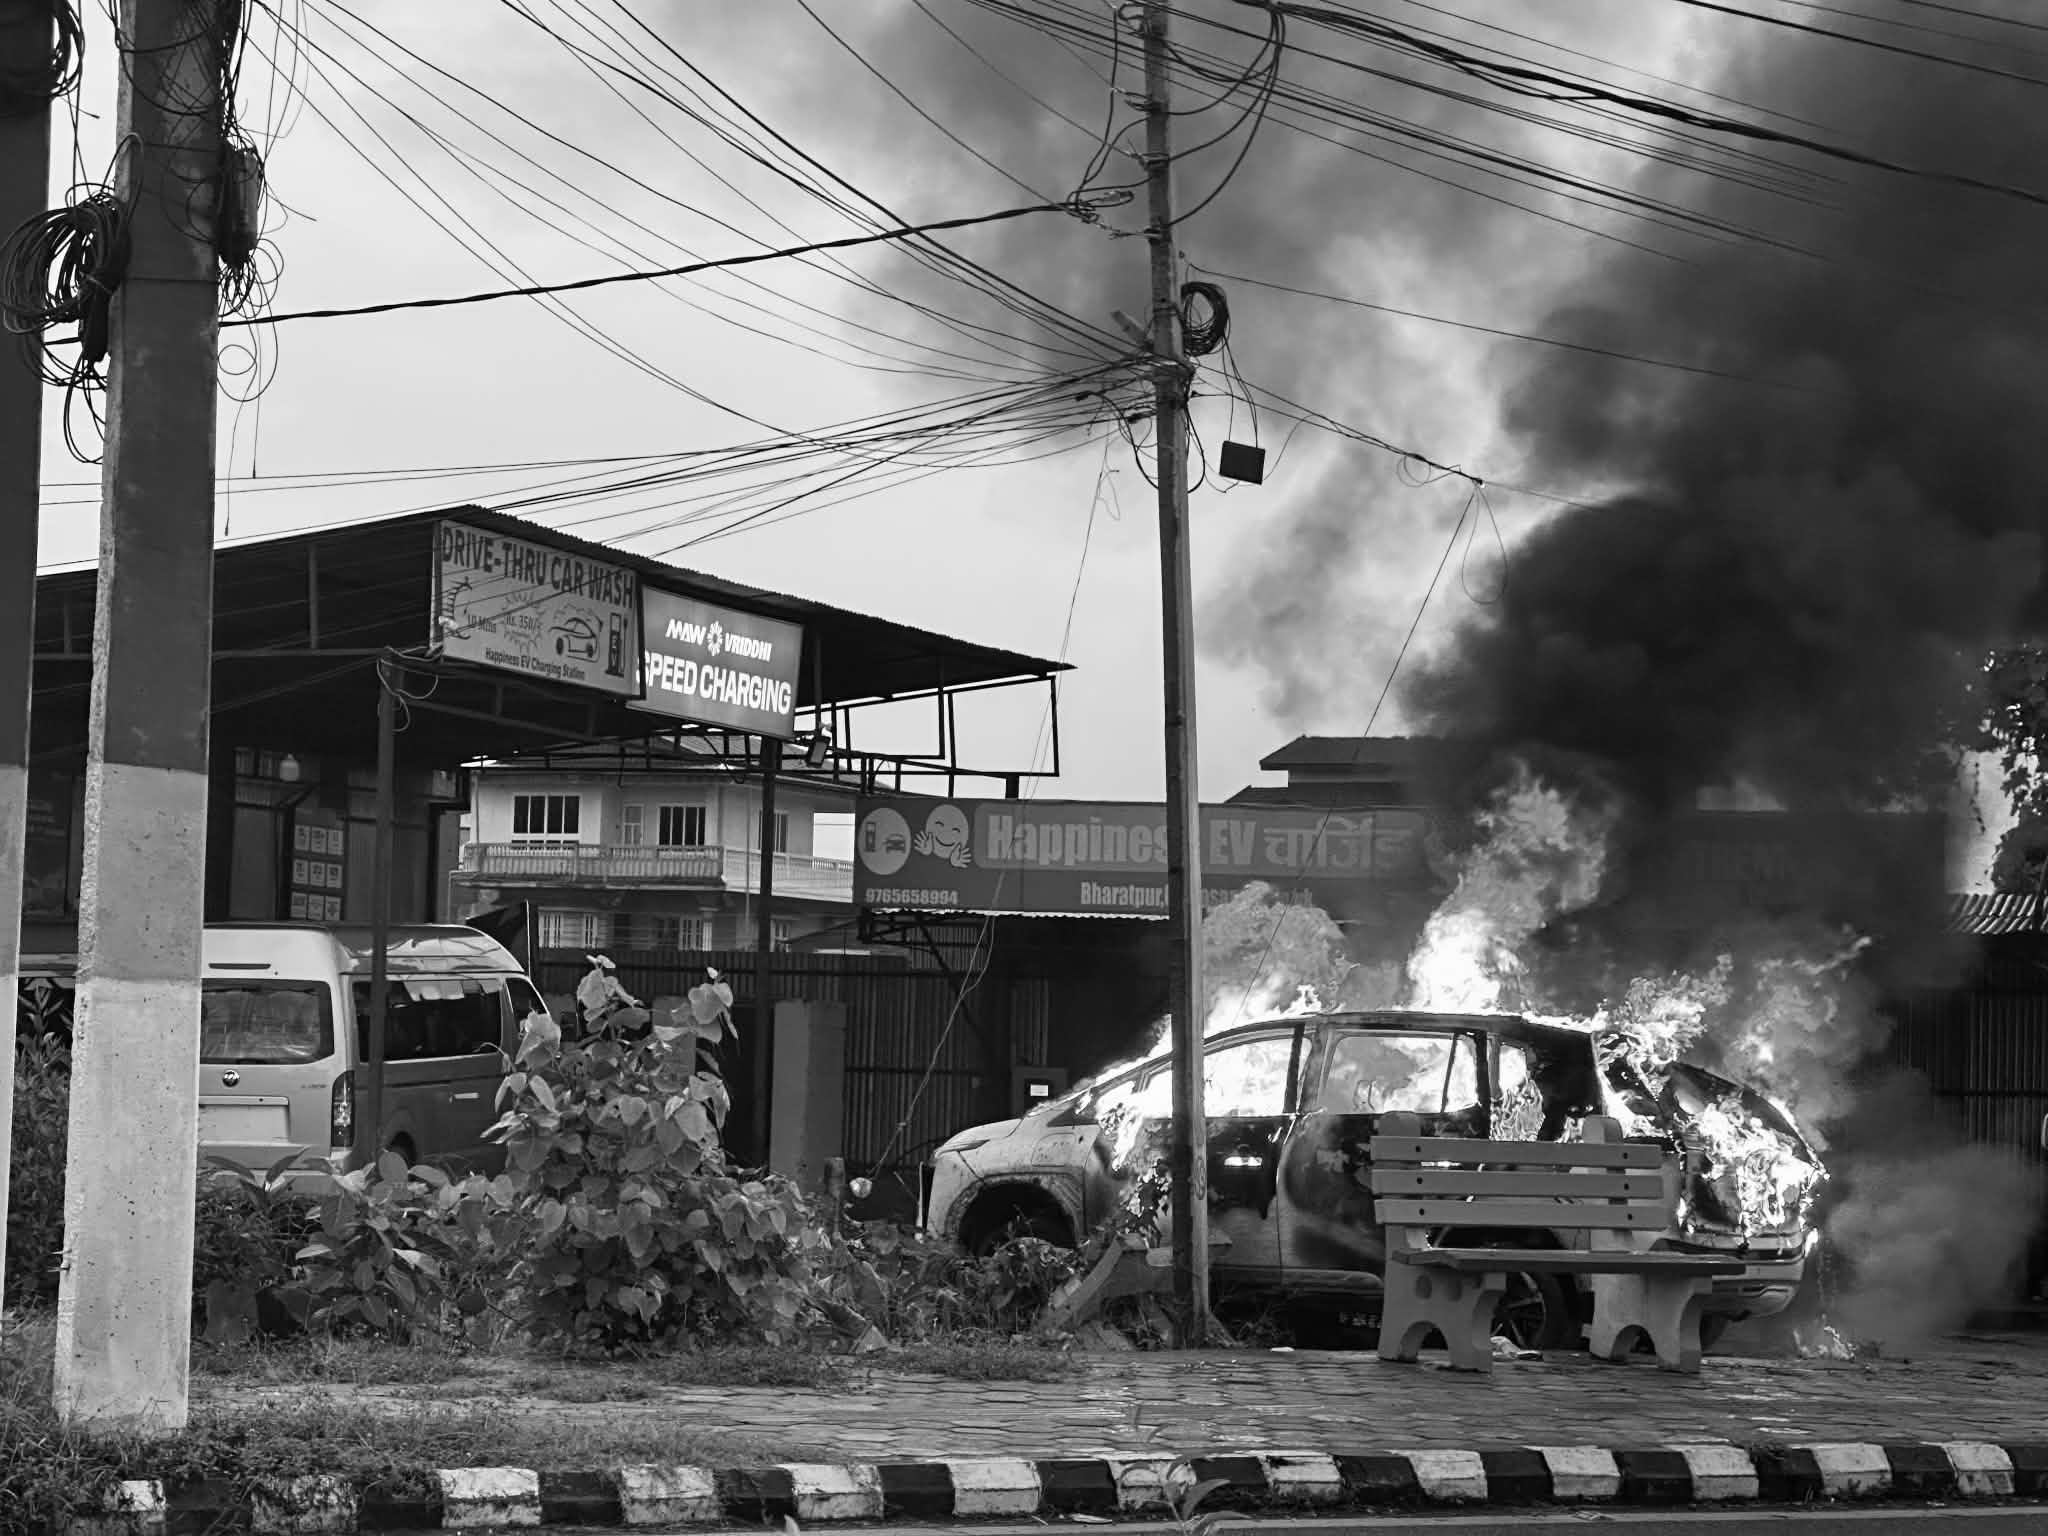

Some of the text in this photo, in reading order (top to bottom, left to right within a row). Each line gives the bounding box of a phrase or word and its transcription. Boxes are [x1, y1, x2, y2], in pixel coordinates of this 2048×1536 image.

[442, 526, 634, 609] DRIVE-THRU CAR WASH
[665, 618, 773, 662] MAW VRIDDHI
[700, 664, 792, 715] CHARGING
[986, 814, 1256, 867] Happines EV
